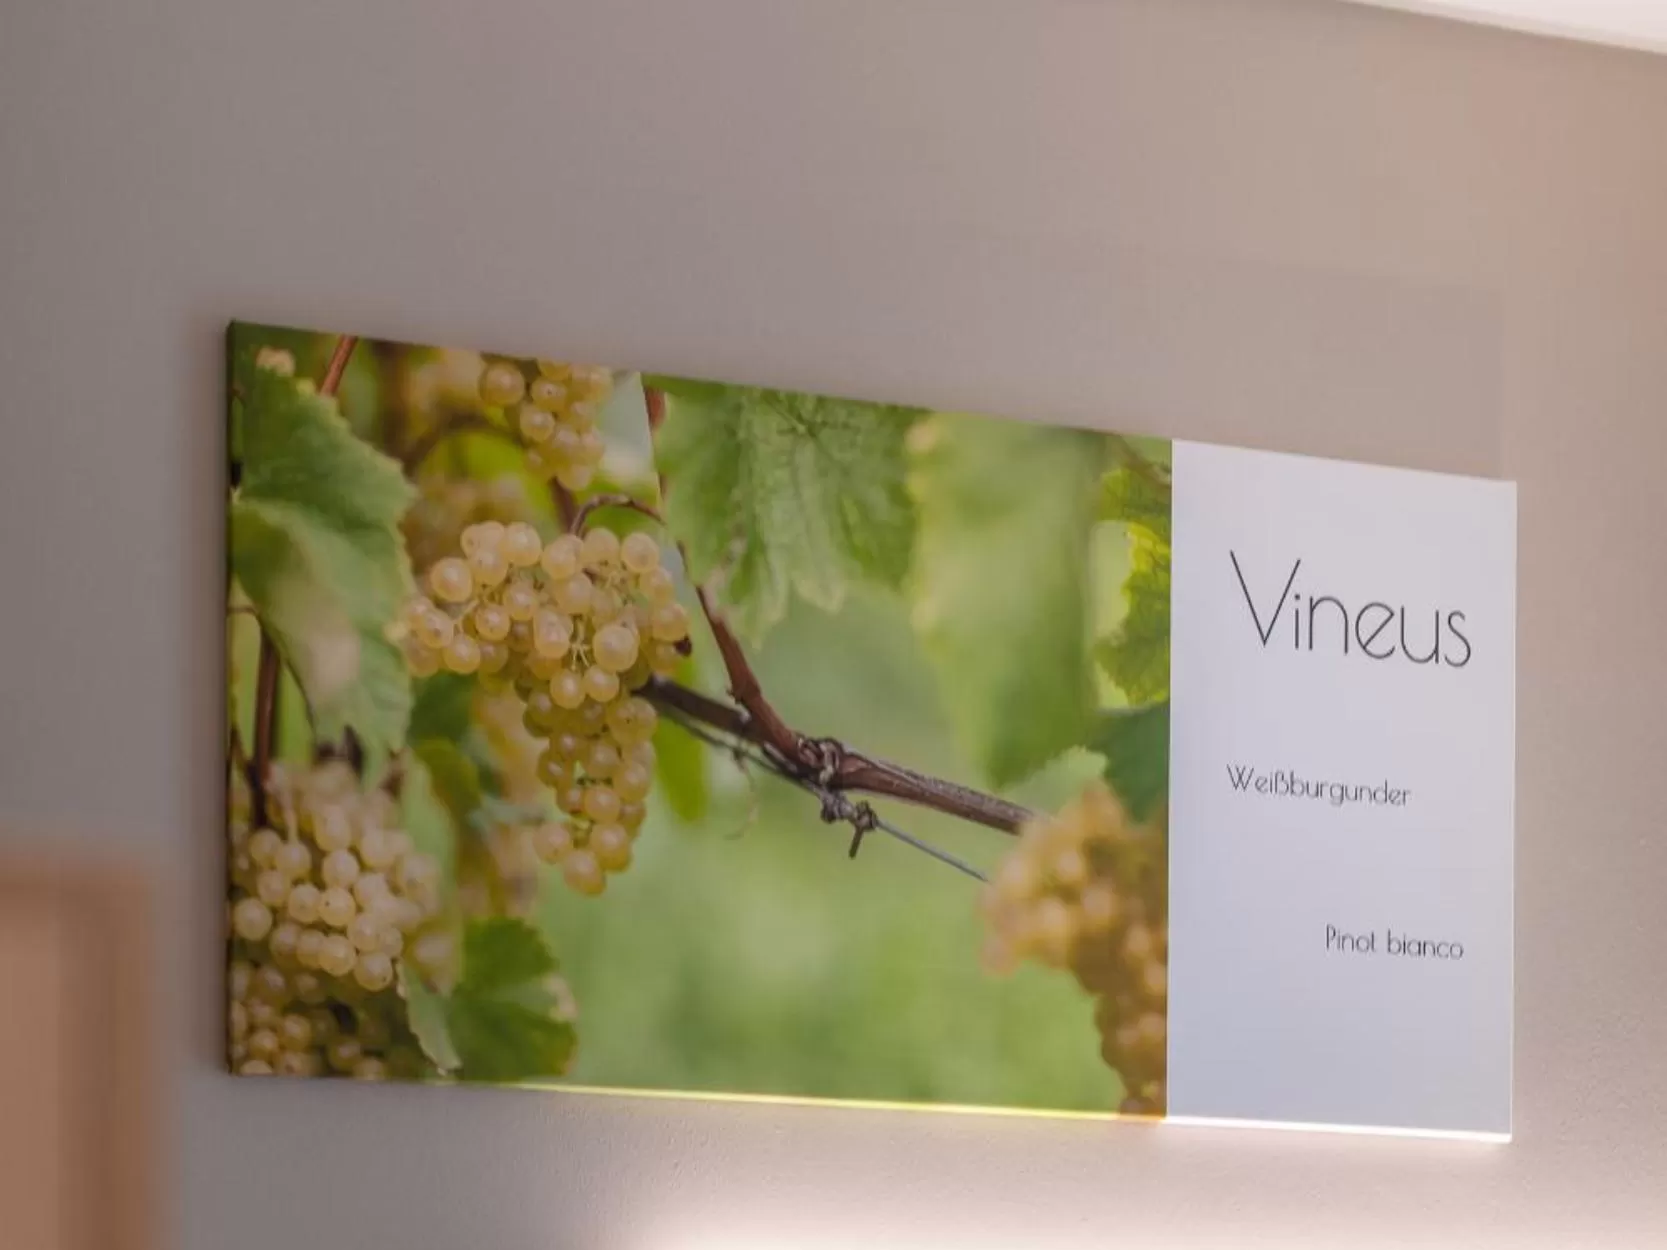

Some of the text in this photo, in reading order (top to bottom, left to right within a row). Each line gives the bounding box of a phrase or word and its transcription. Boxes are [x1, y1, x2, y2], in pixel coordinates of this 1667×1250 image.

[1230, 550, 1471, 668] Vineus
[1227, 763, 1411, 806] Weißburgunder
[1325, 924, 1464, 959] Pinot bianco
